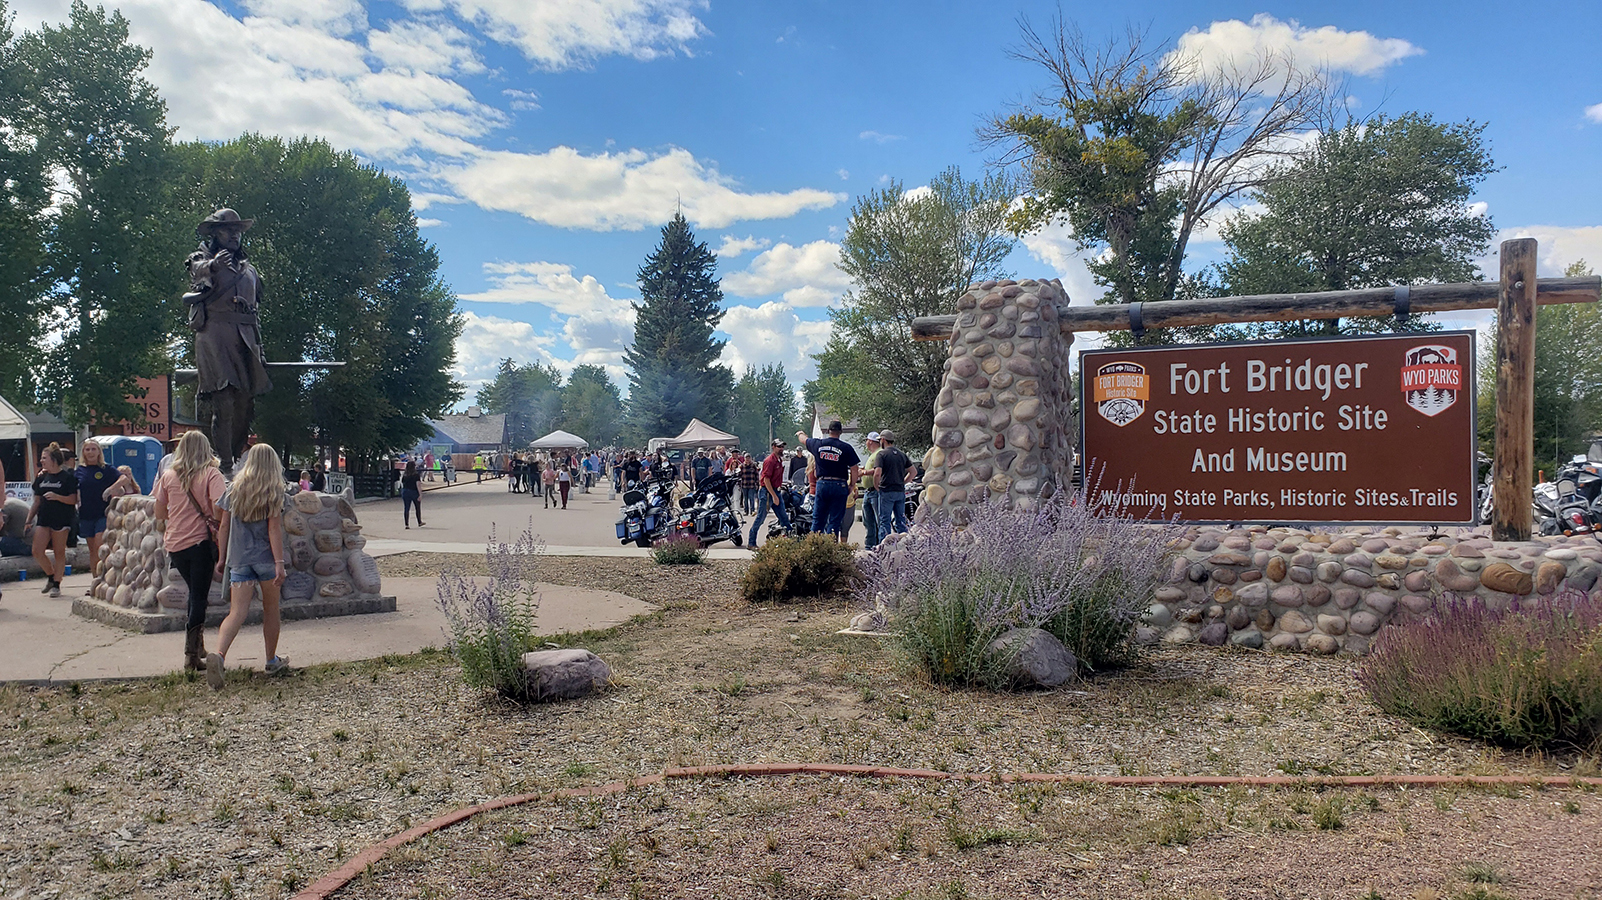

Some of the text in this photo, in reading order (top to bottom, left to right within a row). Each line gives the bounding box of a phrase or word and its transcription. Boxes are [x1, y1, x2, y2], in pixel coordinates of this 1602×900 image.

[1100, 375, 1143, 389] FORT BRIDGER
[1170, 358, 1369, 401] Fort Bridger
[1403, 368, 1459, 387] WYO PARKS
[1106, 388, 1136, 398] Historic Site
[1153, 404, 1388, 434] State Historic Site
[149, 423, 165, 434] UP
[820, 452, 840, 461] FIRE
[1191, 447, 1347, 473] And Museum
[332, 485, 342, 493] 10
[1100, 489, 1167, 511] Wyoming
[1174, 489, 1217, 506] State
[1223, 489, 1276, 509] Parks,
[1280, 488, 1347, 506] Historic
